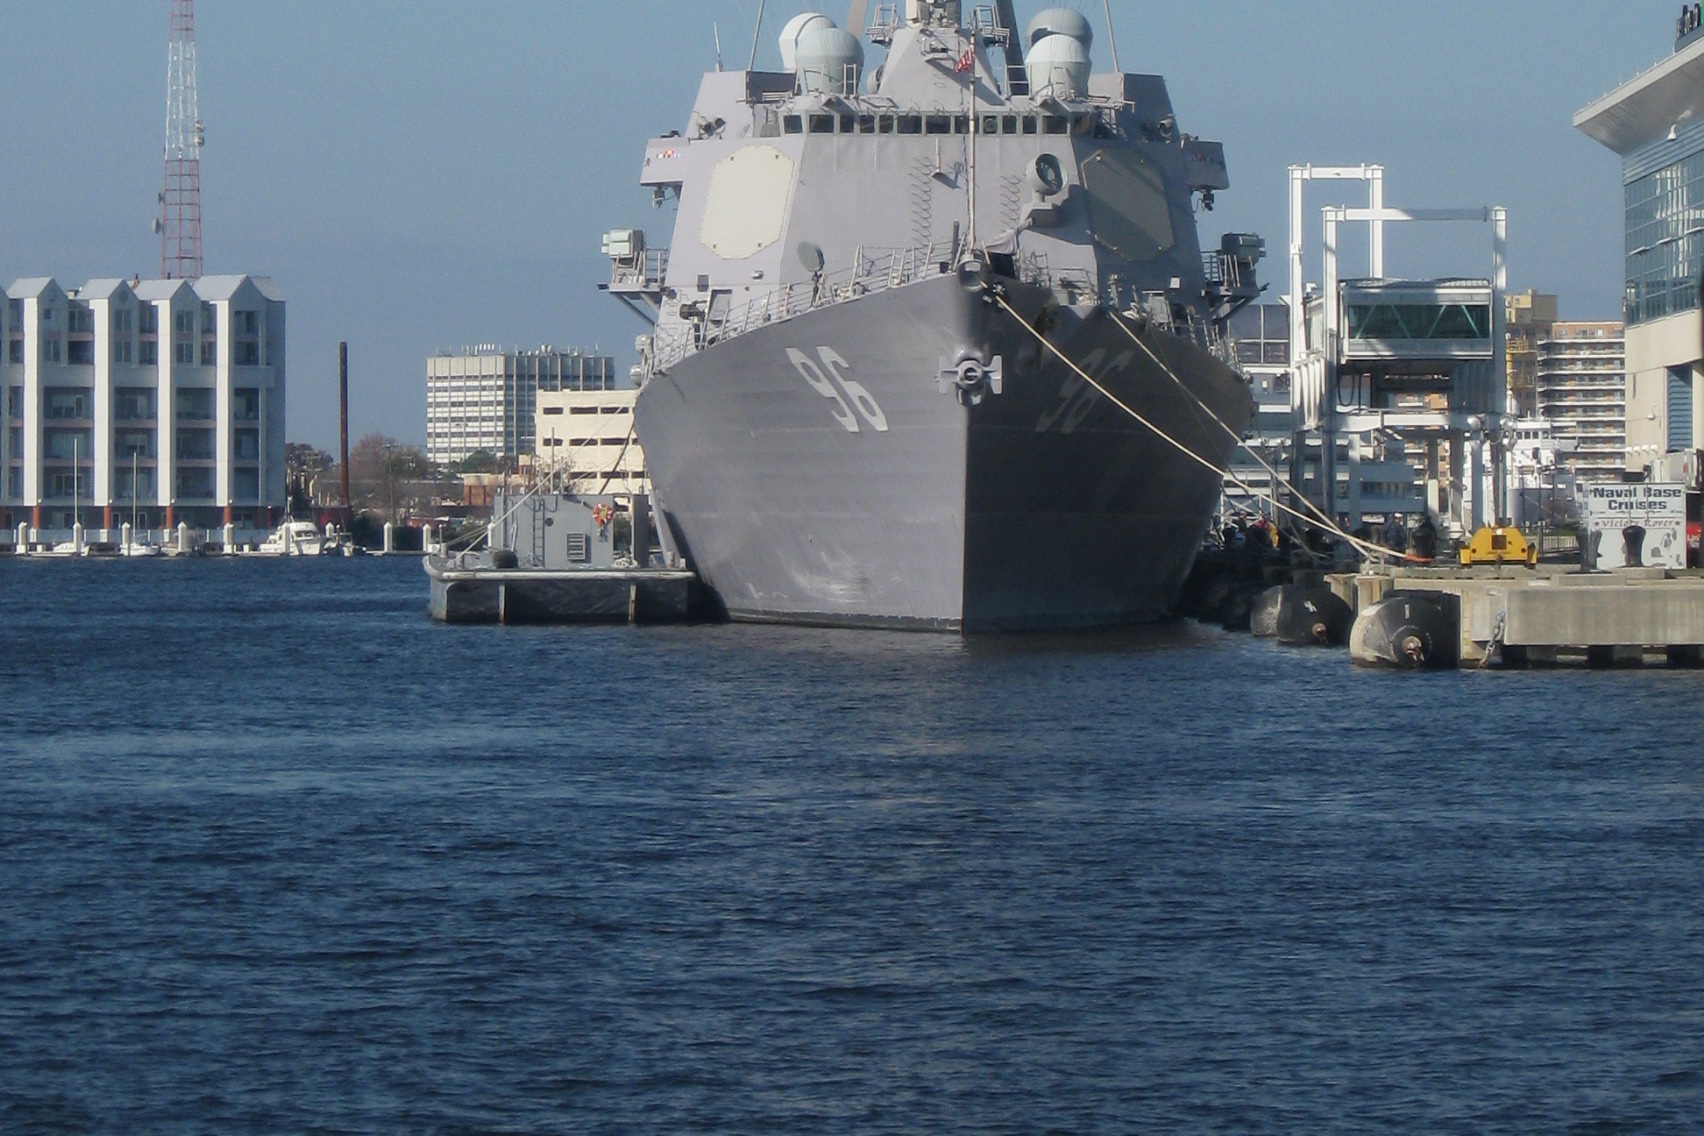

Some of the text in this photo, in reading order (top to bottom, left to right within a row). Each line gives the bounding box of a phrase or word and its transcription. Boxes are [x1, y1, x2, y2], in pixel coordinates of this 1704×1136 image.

[785, 346, 888, 432] 96
[1036, 348, 1135, 433] 96
[1593, 487, 1682, 498] Naval Base
[1608, 499, 1667, 510] Cruises
